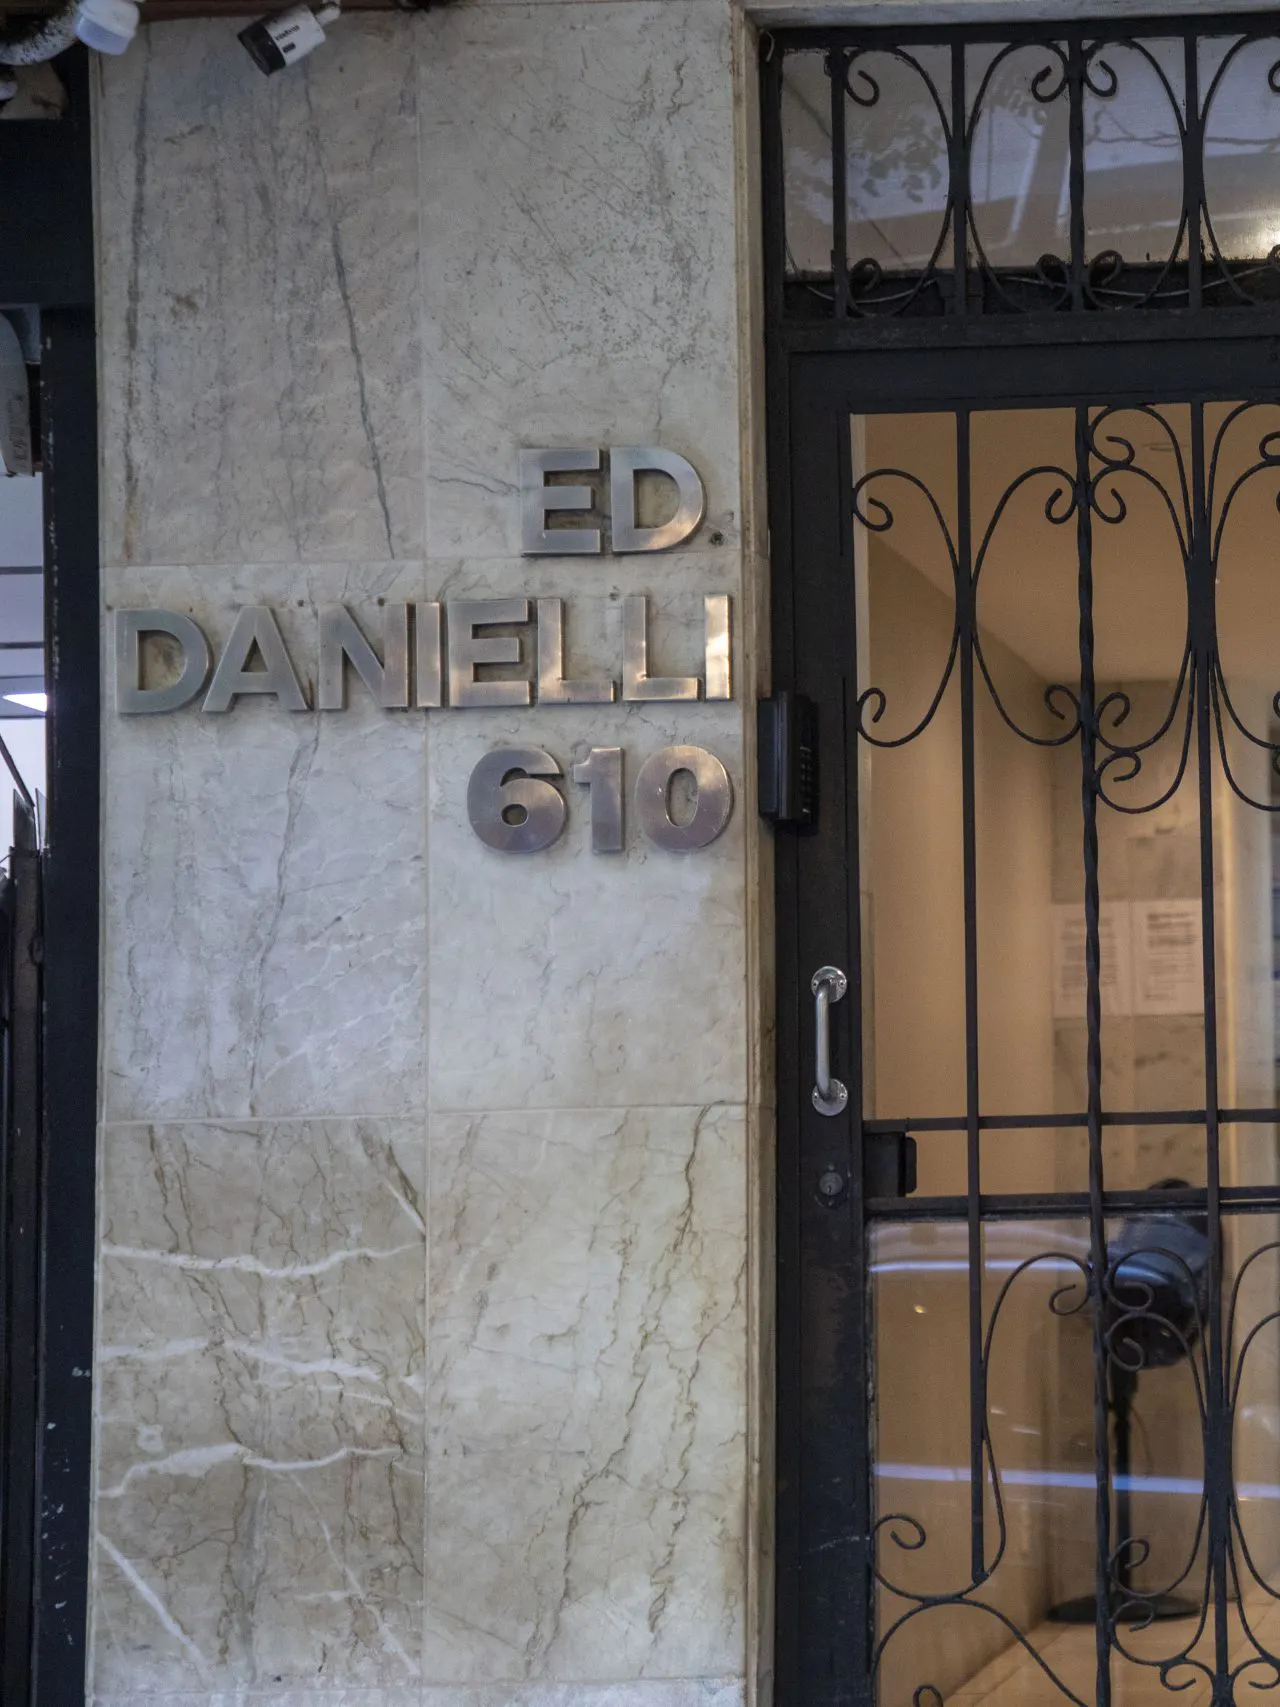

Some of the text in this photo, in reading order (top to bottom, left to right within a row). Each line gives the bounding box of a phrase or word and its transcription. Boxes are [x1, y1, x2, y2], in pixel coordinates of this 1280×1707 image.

[519, 446, 705, 557] ED
[113, 595, 731, 714] DANIELLI
[467, 745, 733, 855] 610
